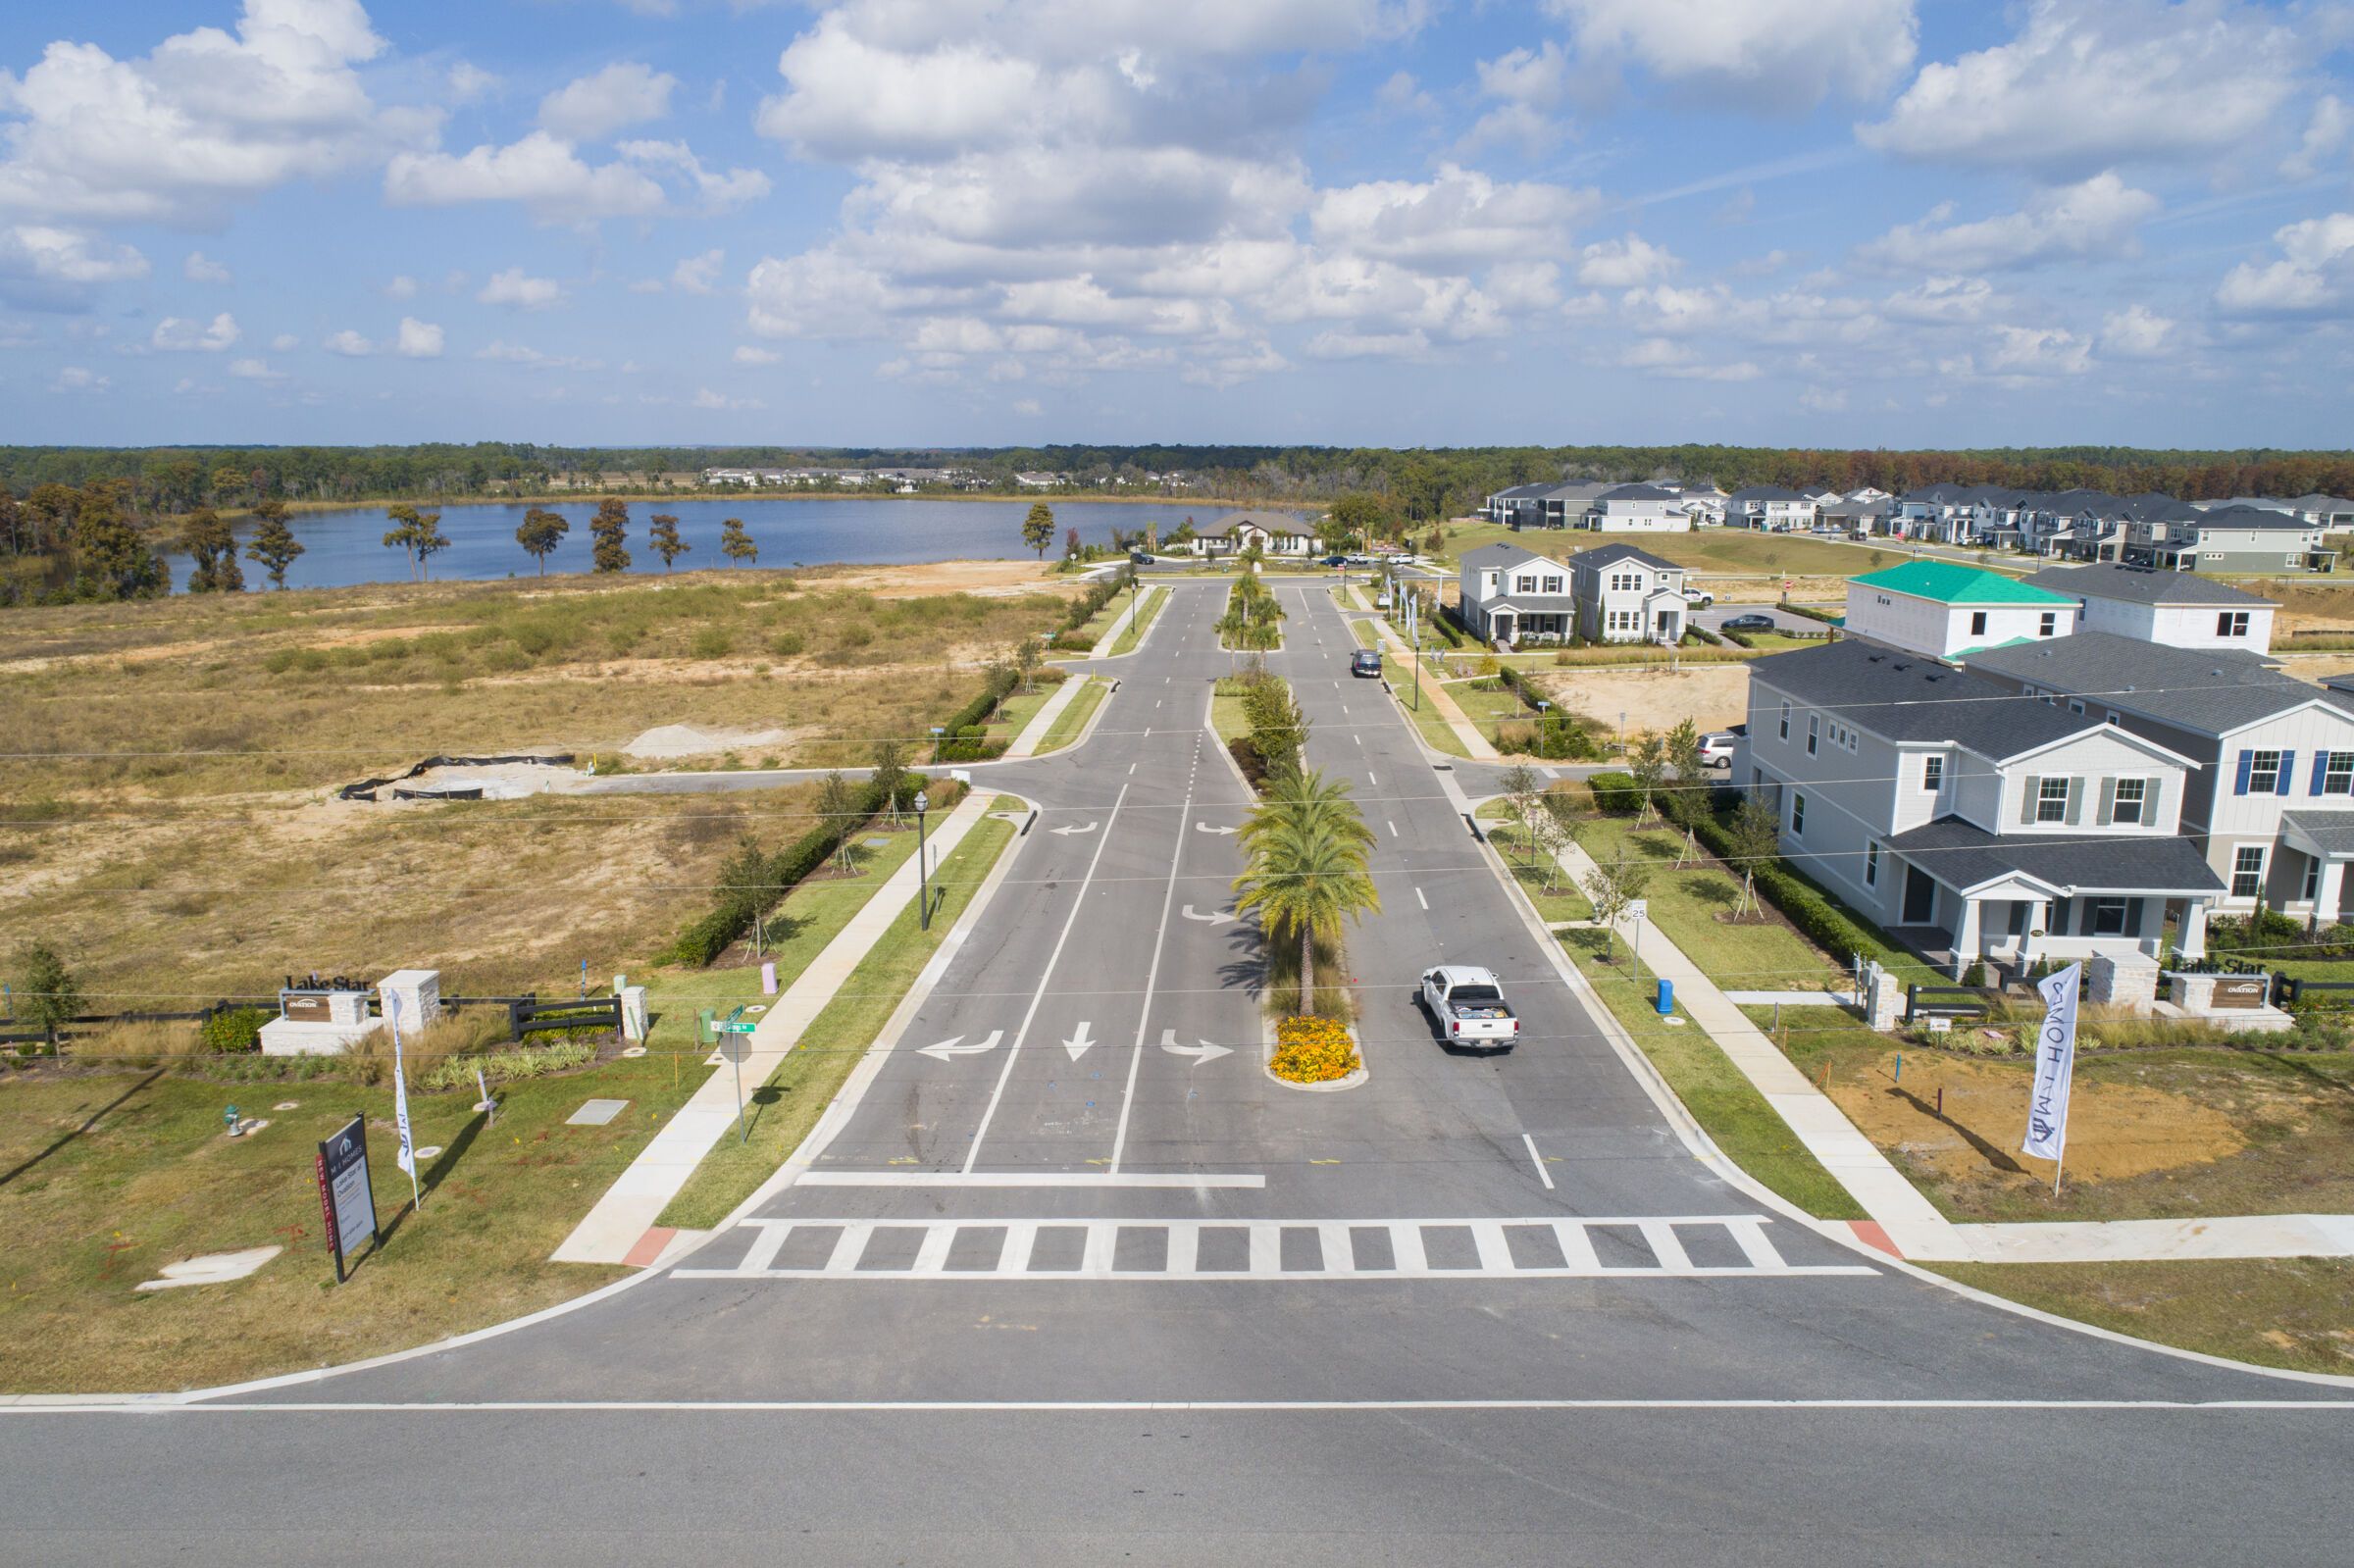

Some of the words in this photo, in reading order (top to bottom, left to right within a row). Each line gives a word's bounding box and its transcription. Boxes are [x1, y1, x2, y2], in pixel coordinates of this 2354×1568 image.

[2172, 957, 2220, 974] Lake
[2224, 959, 2267, 975] Star
[284, 975, 331, 990] Lake
[333, 976, 371, 990] Star
[317, 1160, 326, 1181] NEW
[321, 1184, 332, 1218] MODEL
